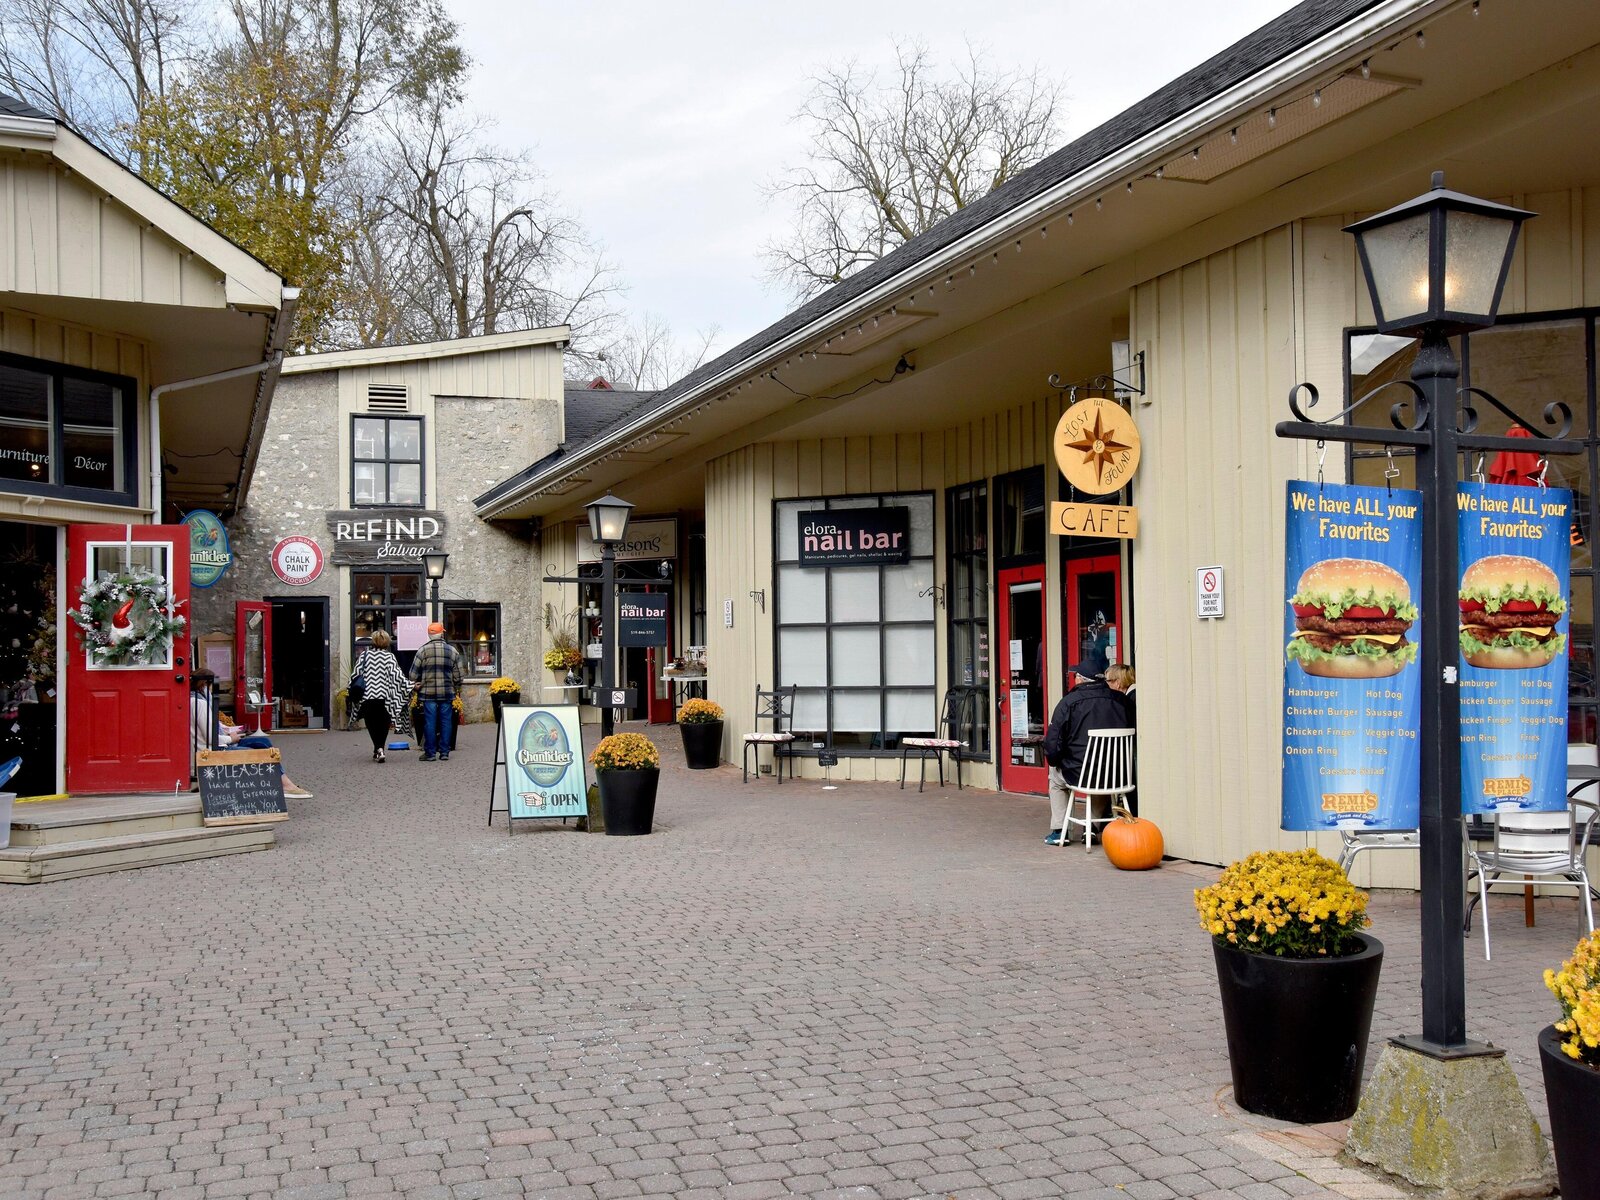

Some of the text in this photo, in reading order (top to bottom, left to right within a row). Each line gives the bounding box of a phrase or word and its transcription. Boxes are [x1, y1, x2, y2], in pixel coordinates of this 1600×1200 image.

[1064, 410, 1088, 440] LOST
[0, 449, 50, 464] urniture
[74, 456, 107, 471] Décor
[1104, 450, 1132, 485] FOUND
[1292, 492, 1417, 520] We have ALL your
[1457, 492, 1566, 518] We have ALL your
[1060, 508, 1129, 534] CAFE
[337, 518, 439, 541] REFIND
[804, 522, 836, 536] elora
[1319, 518, 1390, 543] Favorites
[1480, 517, 1542, 540] Favorites
[604, 537, 660, 552] easons
[804, 530, 902, 552] nail bar
[190, 550, 230, 562] anticleer
[285, 556, 310, 564] CHALK
[286, 564, 308, 572] PAINT
[282, 574, 312, 584] STOCKIST
[621, 608, 666, 616] nail bar
[1460, 680, 1498, 689] amburger
[1521, 680, 1552, 689] Hot Dog
[1288, 688, 1339, 699] Hamburger
[1366, 690, 1403, 700] Hot Dog
[1460, 697, 1514, 706] icken Burger
[1520, 697, 1553, 706] Sausage
[1286, 707, 1358, 718] Chicken Burger
[1366, 708, 1403, 718] Sausage
[1488, 716, 1512, 726] Finger
[1520, 716, 1564, 725] Veggie Dog
[1286, 726, 1356, 737] Chicken Finger
[1365, 728, 1416, 738] Veggie Dog
[1479, 734, 1497, 743] Ring
[1286, 746, 1338, 757] Onion Ring
[1365, 747, 1388, 755] Fries
[518, 750, 570, 765] Chanticleer
[214, 764, 264, 779] PLEASE
[242, 790, 278, 799] ENTERING
[228, 799, 278, 810] THANK YOU
[551, 794, 579, 807] OPEN
